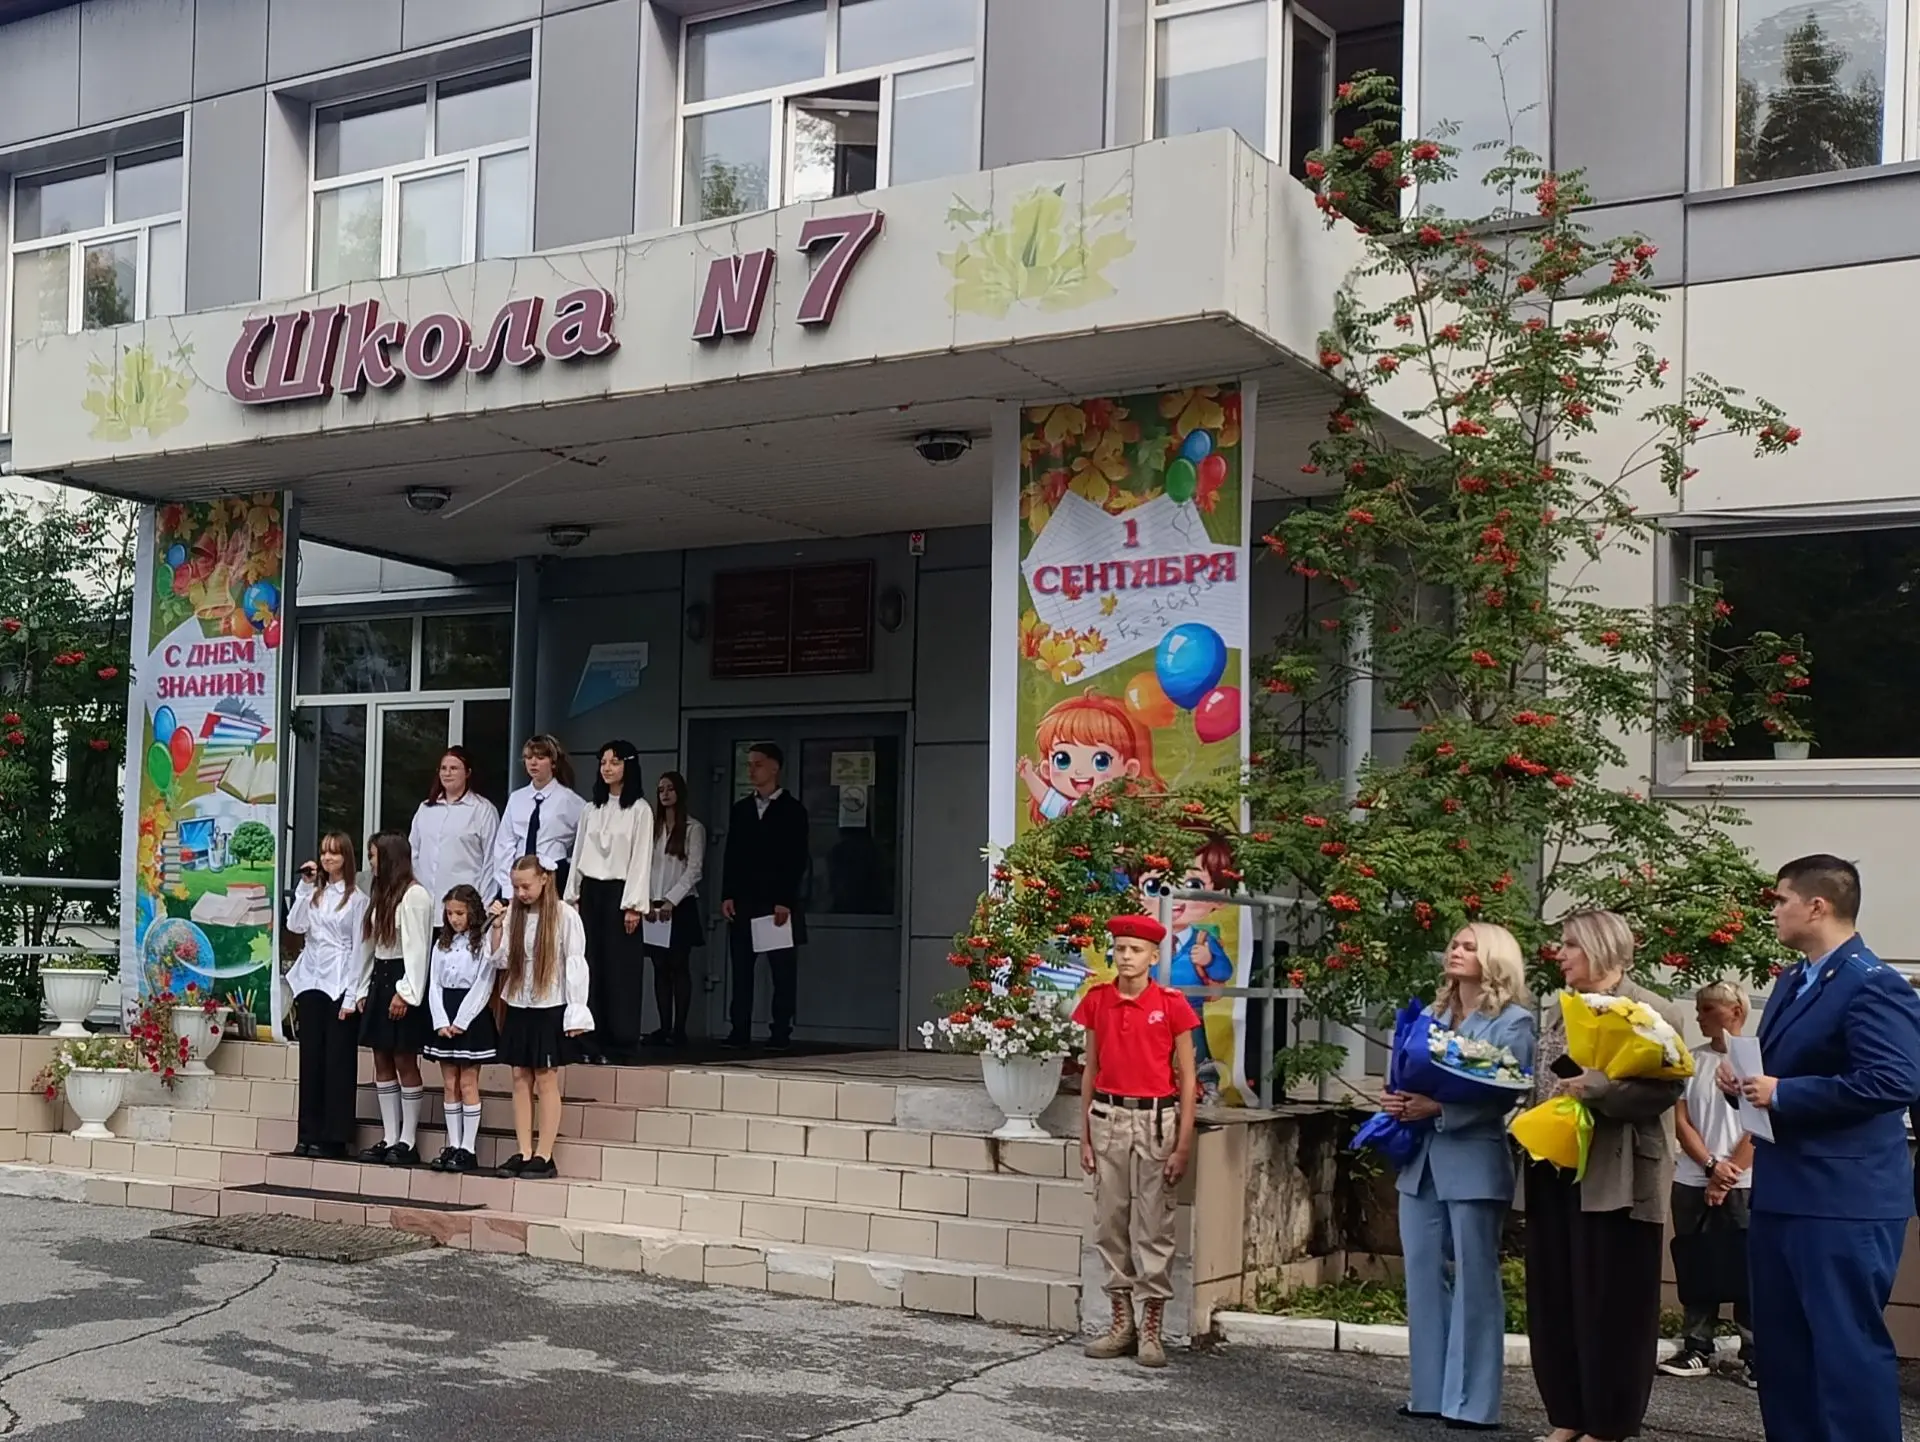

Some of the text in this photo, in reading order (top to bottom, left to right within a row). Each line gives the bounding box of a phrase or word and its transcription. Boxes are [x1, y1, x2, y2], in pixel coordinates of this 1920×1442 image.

[225, 287, 619, 405] Школа
[796, 209, 885, 327] 7
[1123, 518, 1139, 548] 1
[1032, 551, 1237, 596] СЕНТЯБРЯ
[164, 641, 255, 668] С ДНЕМ
[156, 668, 266, 699] ЗНАНИЙ!
